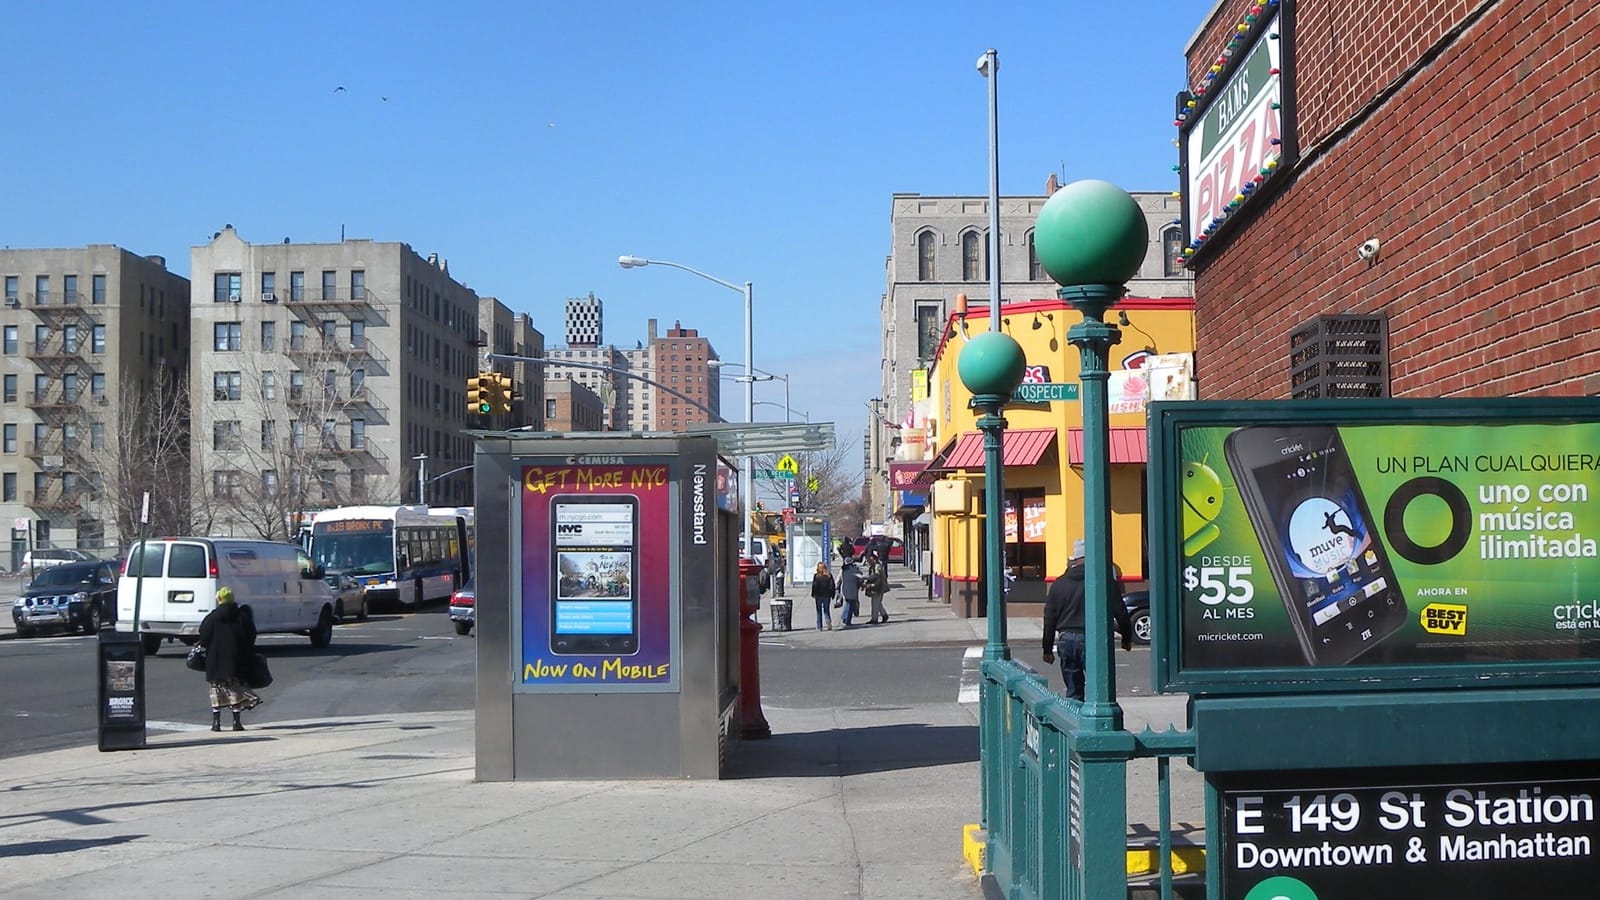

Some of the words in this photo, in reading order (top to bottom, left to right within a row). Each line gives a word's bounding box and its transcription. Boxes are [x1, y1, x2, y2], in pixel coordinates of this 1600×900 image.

[1218, 68, 1249, 134] BAMS
[1195, 97, 1281, 237] PIZZA
[1013, 385, 1063, 398] ROSPECT
[578, 456, 624, 465] CEMUSA
[1376, 457, 1407, 473] UN
[1413, 456, 1468, 473] PLAN
[525, 467, 571, 494] GET
[576, 468, 624, 491] MORE
[631, 467, 666, 490] NYC
[1479, 484, 1531, 503] uno
[1538, 482, 1588, 502] con
[693, 464, 707, 545] Newsstand
[1479, 505, 1574, 531] música
[558, 524, 582, 533] NYC
[1309, 536, 1343, 558] muve
[1479, 533, 1597, 559] ilimitada
[1201, 555, 1251, 567] DESDE
[1184, 565, 1254, 605] $55
[1417, 588, 1451, 596] AHORA
[1455, 587, 1468, 595] EN
[1202, 609, 1221, 619] AL
[1225, 608, 1255, 619] MES
[1426, 608, 1465, 620] BEST
[1428, 619, 1462, 630] BUY
[1556, 618, 1577, 629] está
[1578, 621, 1592, 629] en
[1198, 632, 1264, 641] micricket.com
[524, 658, 568, 680] NOW
[572, 663, 596, 677] ON
[602, 657, 670, 679] MOBILE
[109, 697, 134, 705] BRONX
[1236, 796, 1265, 834] E
[1283, 793, 1360, 832] 149
[1378, 791, 1427, 831] St
[1444, 786, 1594, 828] Station
[1236, 841, 1393, 869] Downtown
[1405, 836, 1428, 863] &
[1440, 832, 1591, 862] Manhattan
